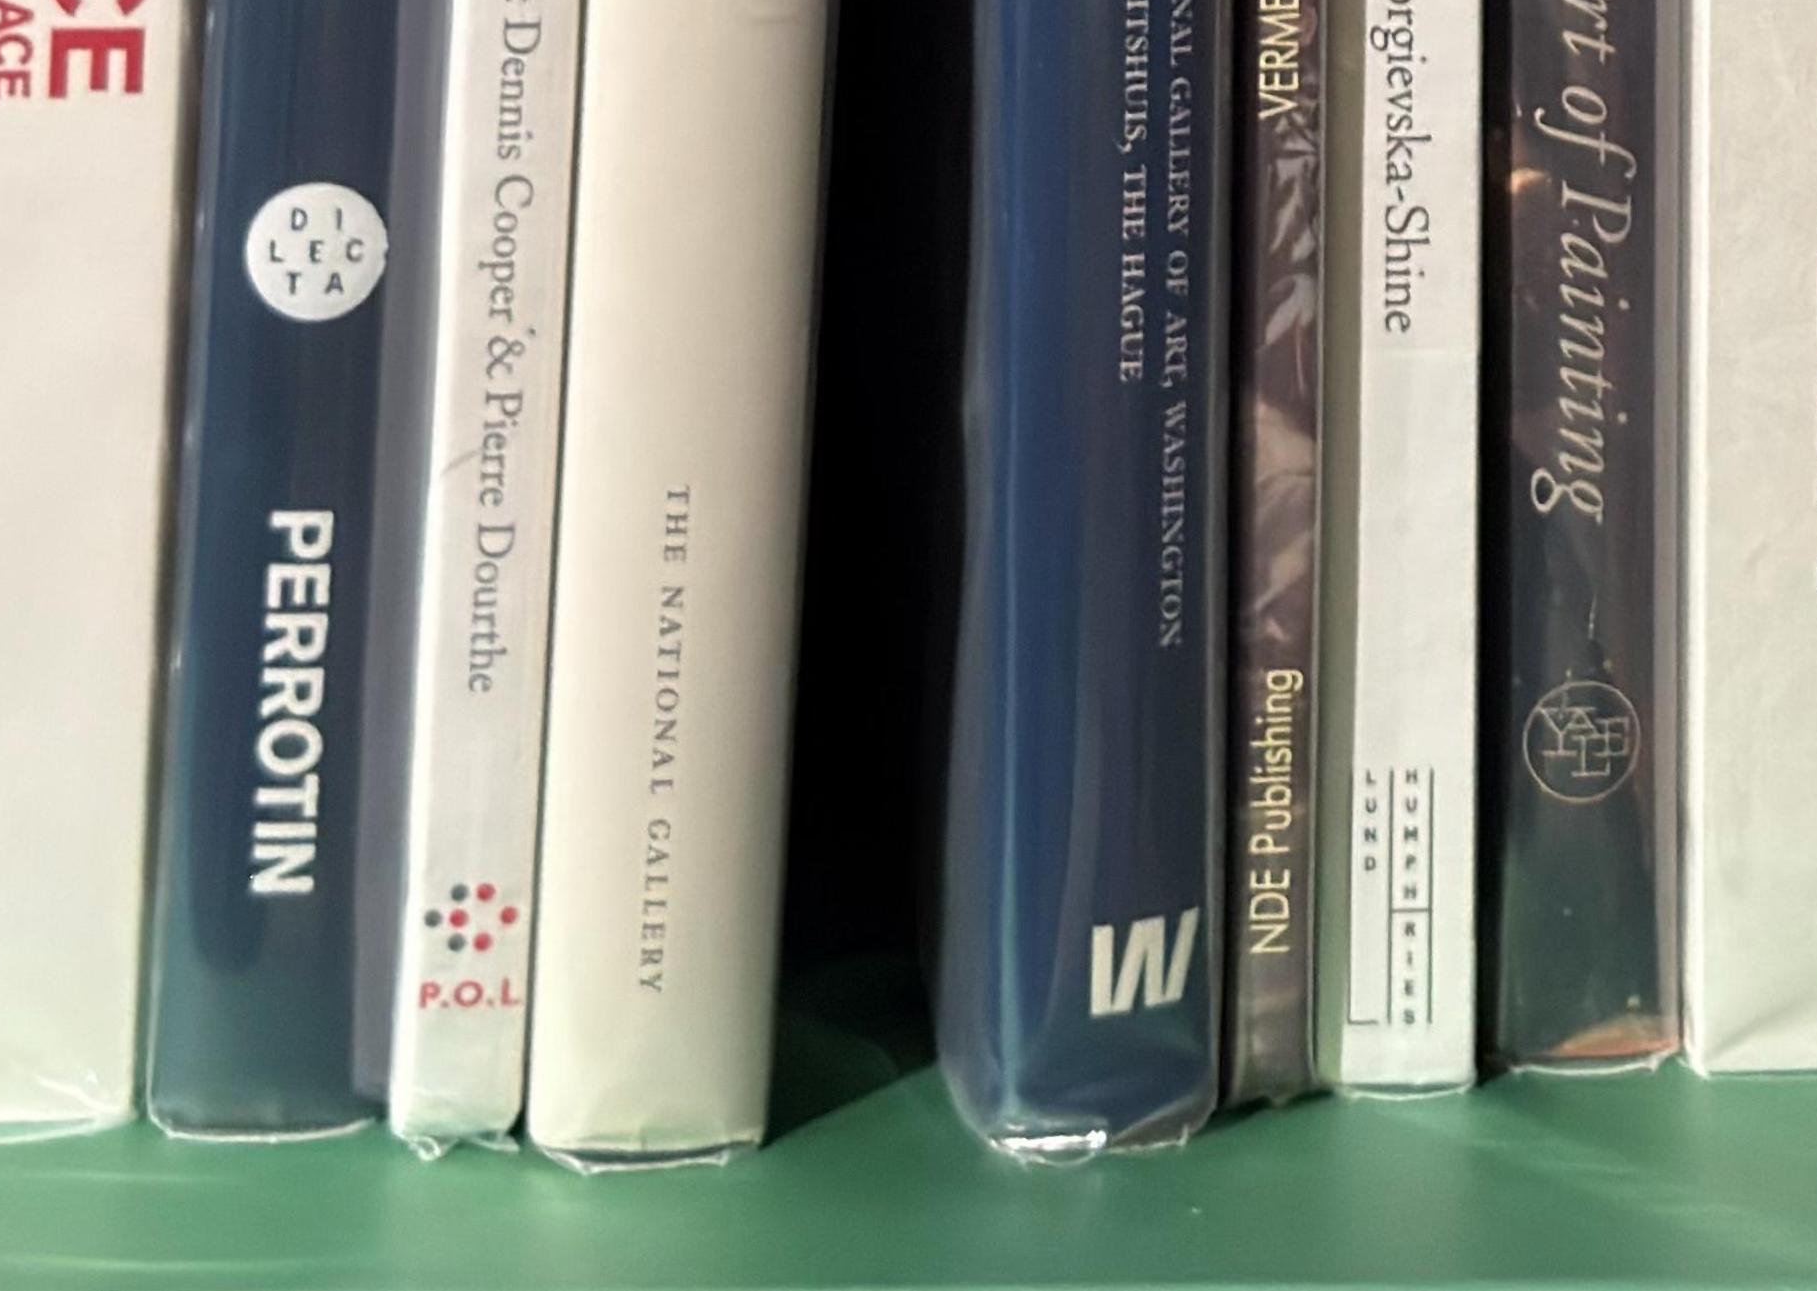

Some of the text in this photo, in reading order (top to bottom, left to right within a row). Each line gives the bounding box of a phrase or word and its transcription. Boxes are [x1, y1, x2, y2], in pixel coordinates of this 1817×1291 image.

[496, 15, 542, 162] Dennis
[1167, 75, 1192, 235] GALLERY
[1534, 88, 1636, 181] of
[478, 174, 534, 321] Cooper
[1121, 164, 1148, 241] THE
[1165, 249, 1190, 296] OF
[486, 334, 527, 380] &
[1119, 253, 1146, 383] HAGUE
[1530, 181, 1631, 524] Painting
[479, 389, 524, 508] Pierre
[1158, 400, 1187, 648] WASHINGTON
[467, 523, 516, 694] Dourthe
[250, 510, 335, 895] PERROTIN
[639, 484, 691, 994] THE NATIONAL GALLERY
[1249, 669, 1304, 954] NDE Publishing
